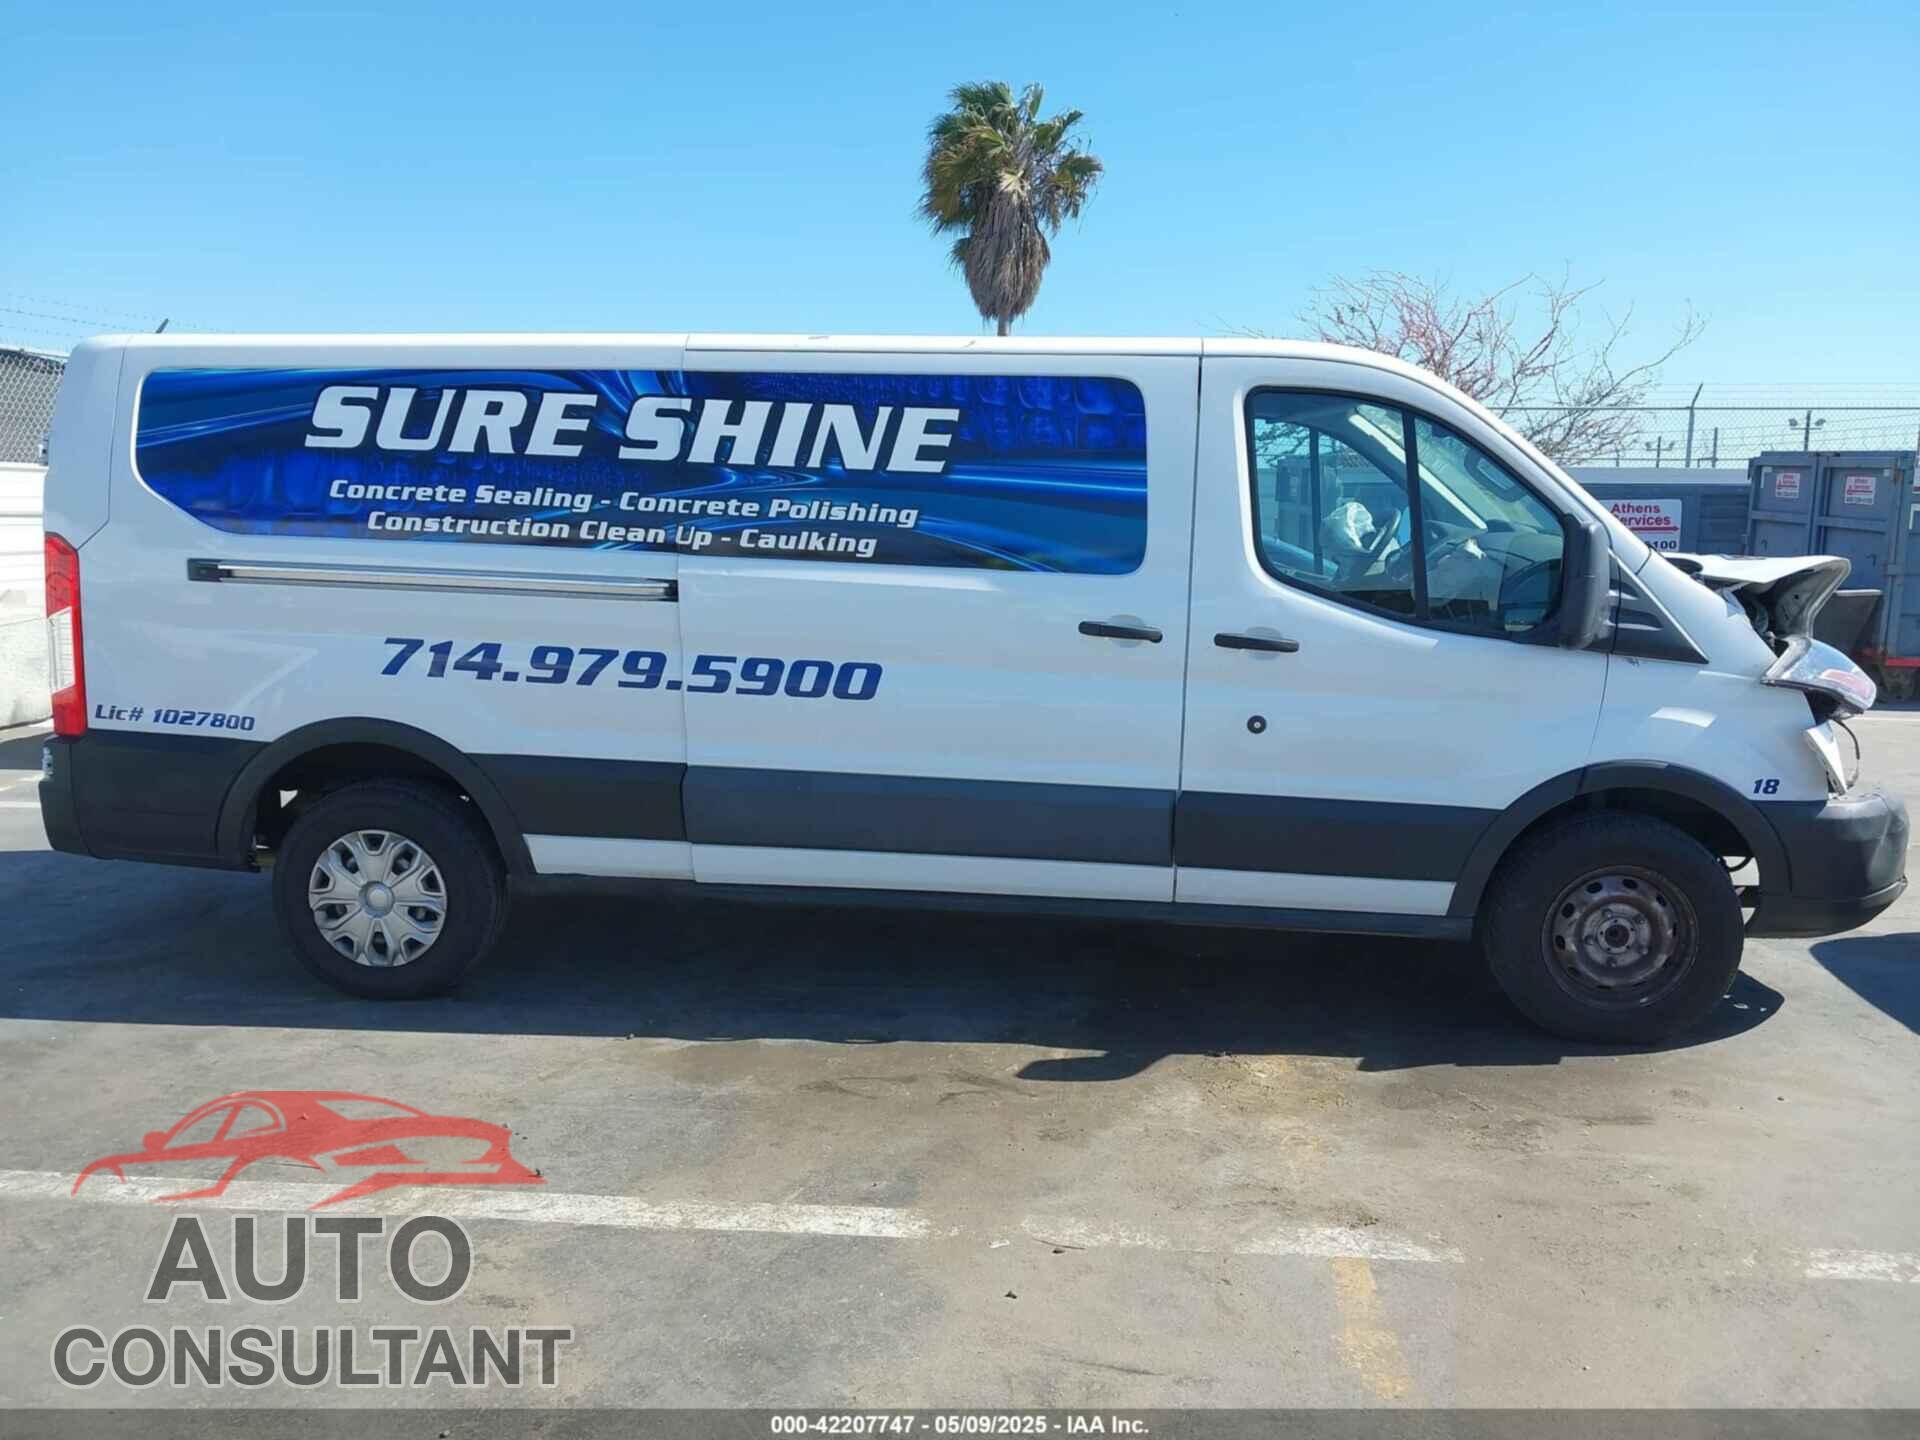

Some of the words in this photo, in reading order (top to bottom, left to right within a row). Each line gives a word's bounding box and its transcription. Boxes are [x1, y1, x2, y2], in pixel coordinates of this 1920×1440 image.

[304, 385, 598, 457] SURE
[618, 396, 960, 473] SHINE
[329, 480, 467, 503] Concrete
[475, 484, 593, 512] Sealing
[619, 492, 760, 517] Concrete
[769, 499, 919, 528] Polishing
[1611, 503, 1660, 514] Athens
[367, 511, 570, 538] Construction
[579, 519, 666, 544] Clean
[675, 524, 713, 550] Up
[739, 529, 878, 558] Caulking
[381, 637, 883, 700] 714.979.5900
[95, 704, 144, 722] Lic#
[153, 708, 255, 731] 1027800
[1753, 779, 1780, 794] 18
